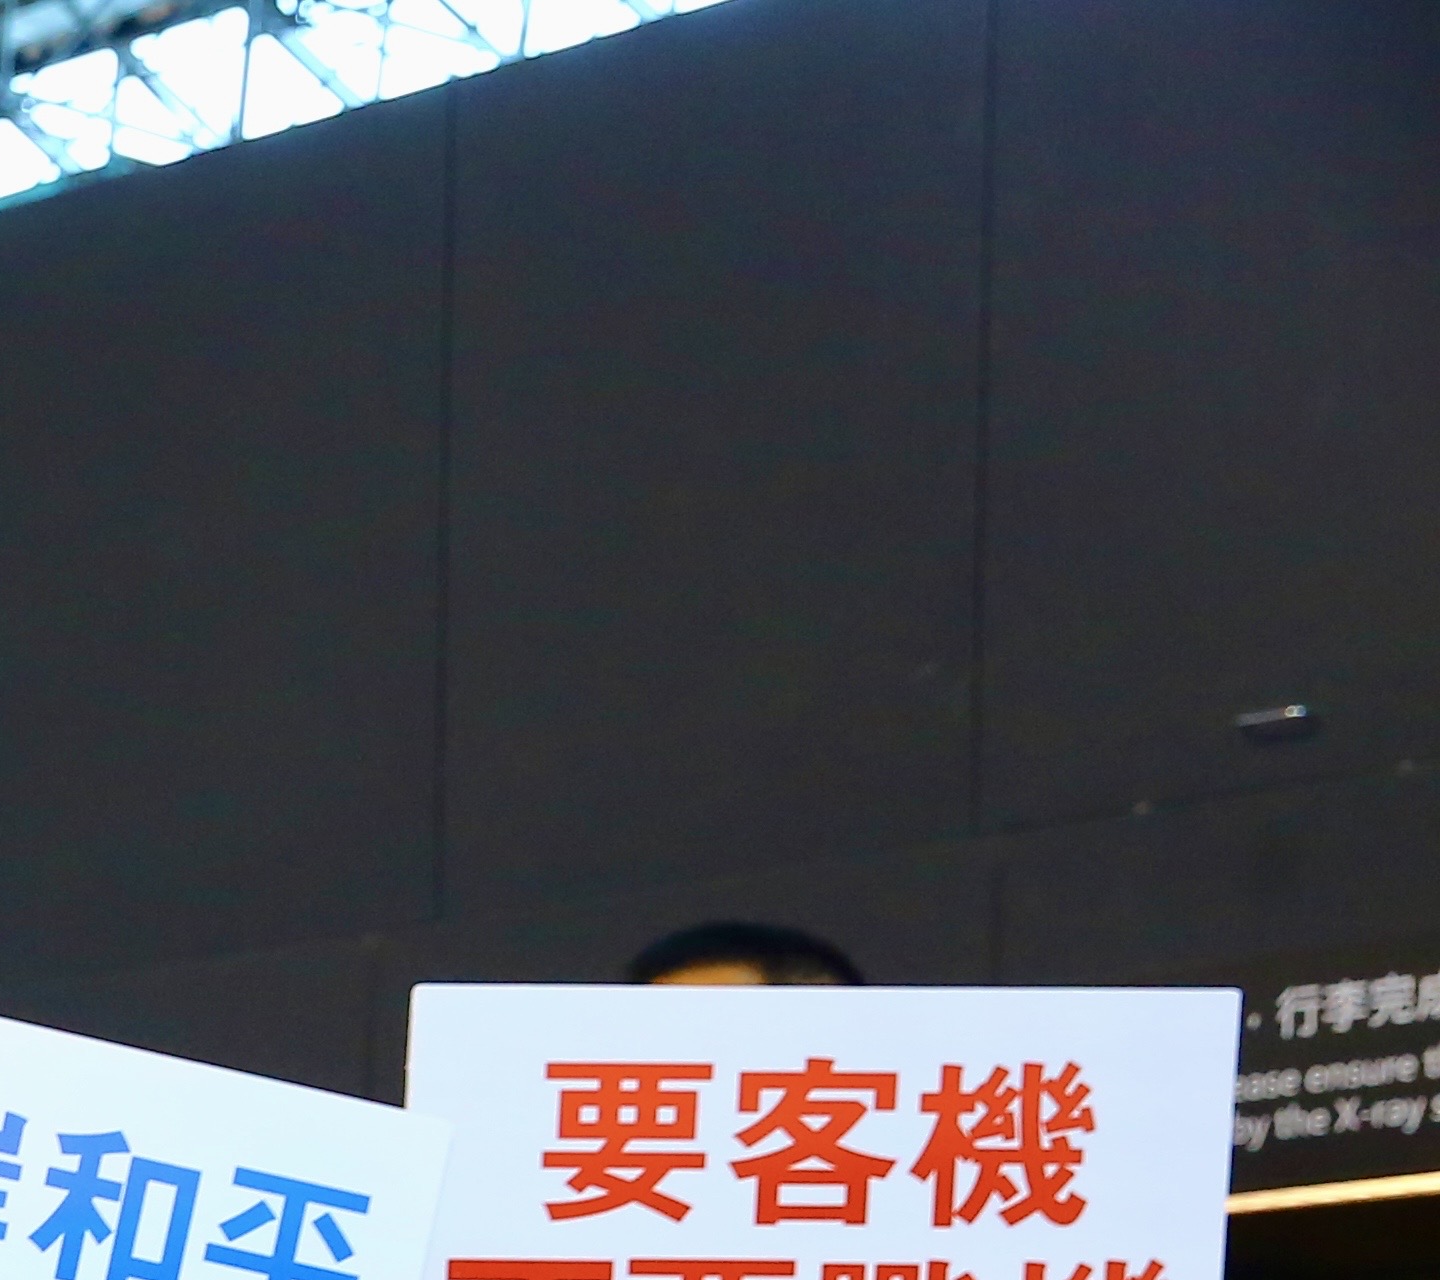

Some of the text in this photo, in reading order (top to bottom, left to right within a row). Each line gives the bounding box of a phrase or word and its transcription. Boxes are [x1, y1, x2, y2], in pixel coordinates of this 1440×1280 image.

[1304, 1052, 1419, 1094] ensure
[1274, 1102, 1331, 1140] the
[1334, 1096, 1427, 1135] X-ray
[542, 1057, 1096, 1229] 要客機
